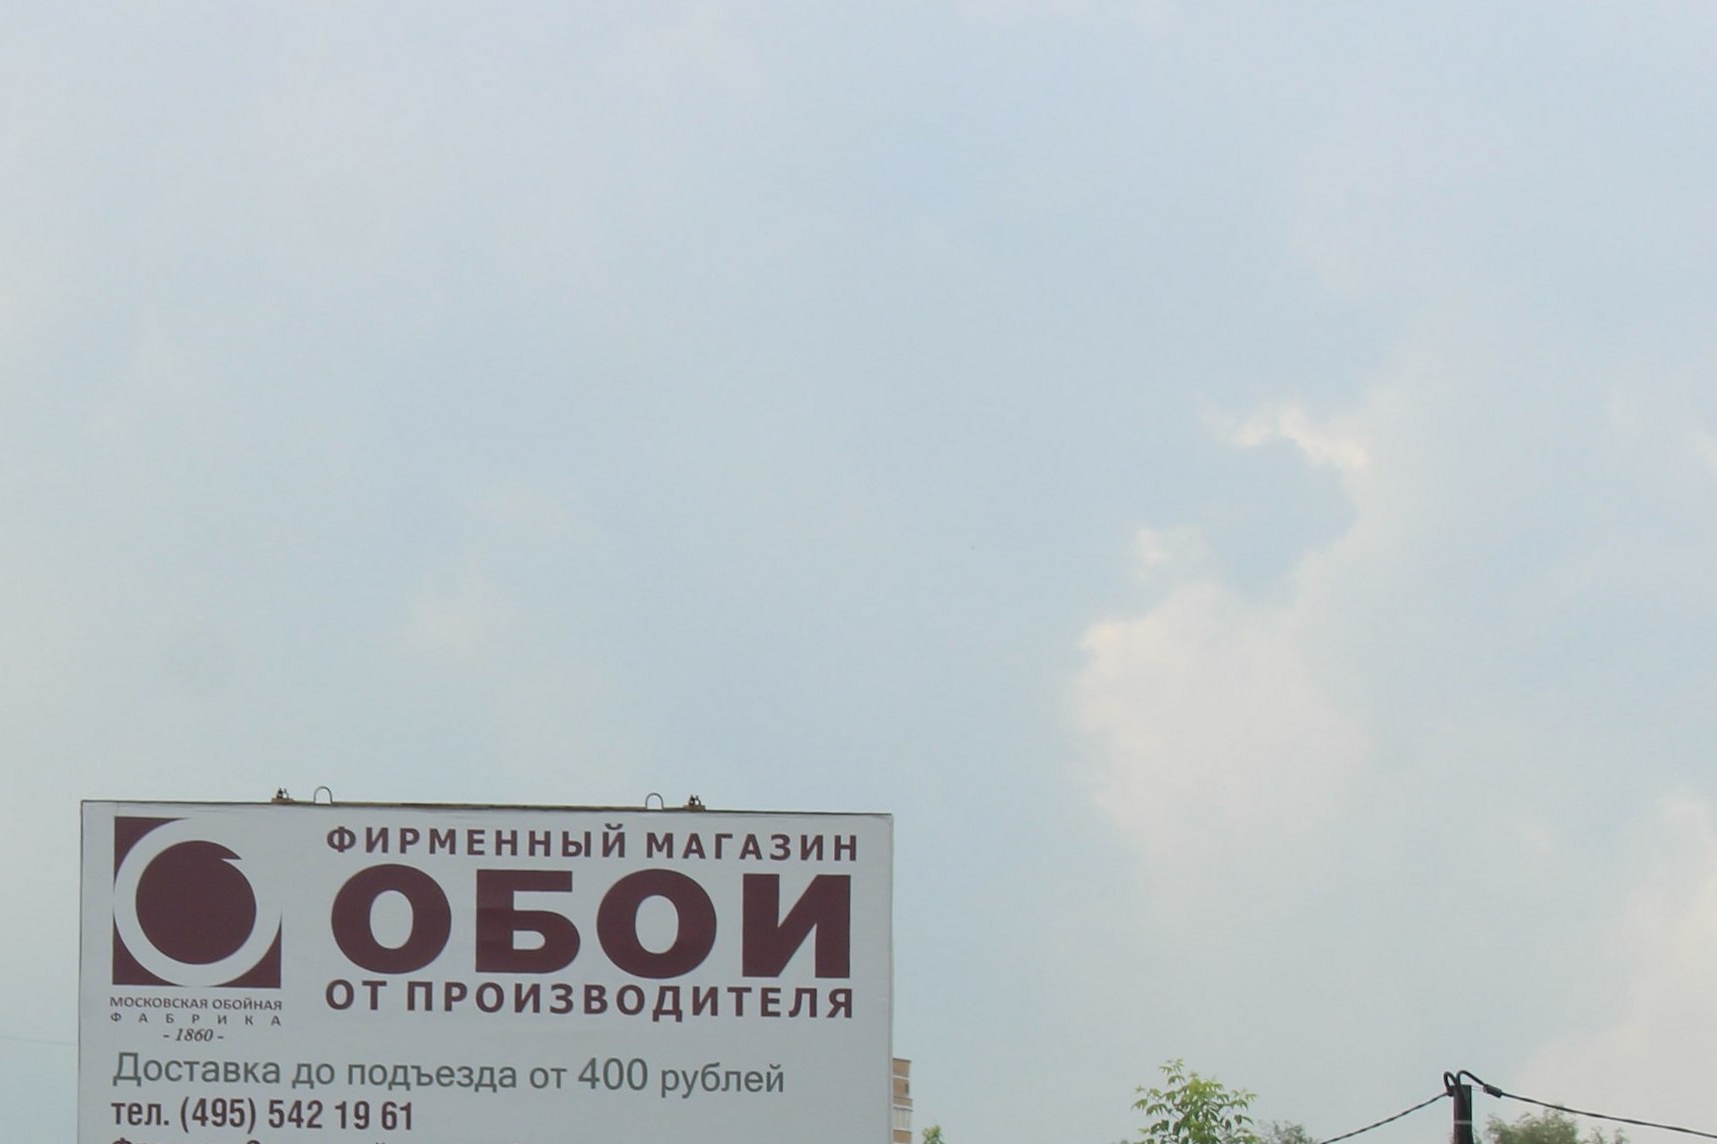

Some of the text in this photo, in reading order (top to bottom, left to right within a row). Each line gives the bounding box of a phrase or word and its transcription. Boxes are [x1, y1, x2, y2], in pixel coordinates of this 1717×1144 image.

[326, 823, 857, 862] ФИРМЕННЫЙ МАГАЗИН
[331, 863, 851, 979] ОБОИ
[110, 996, 282, 1010] МОСКОВСКАЯ ОБОЙНАЯ
[325, 979, 853, 1022] ОТ ПРОИЗВОДИТЕЛЯ
[113, 1052, 785, 1099] Доставка до подъезда от 400 рублей
[111, 1097, 413, 1134] тел. (495) 542 19 61
